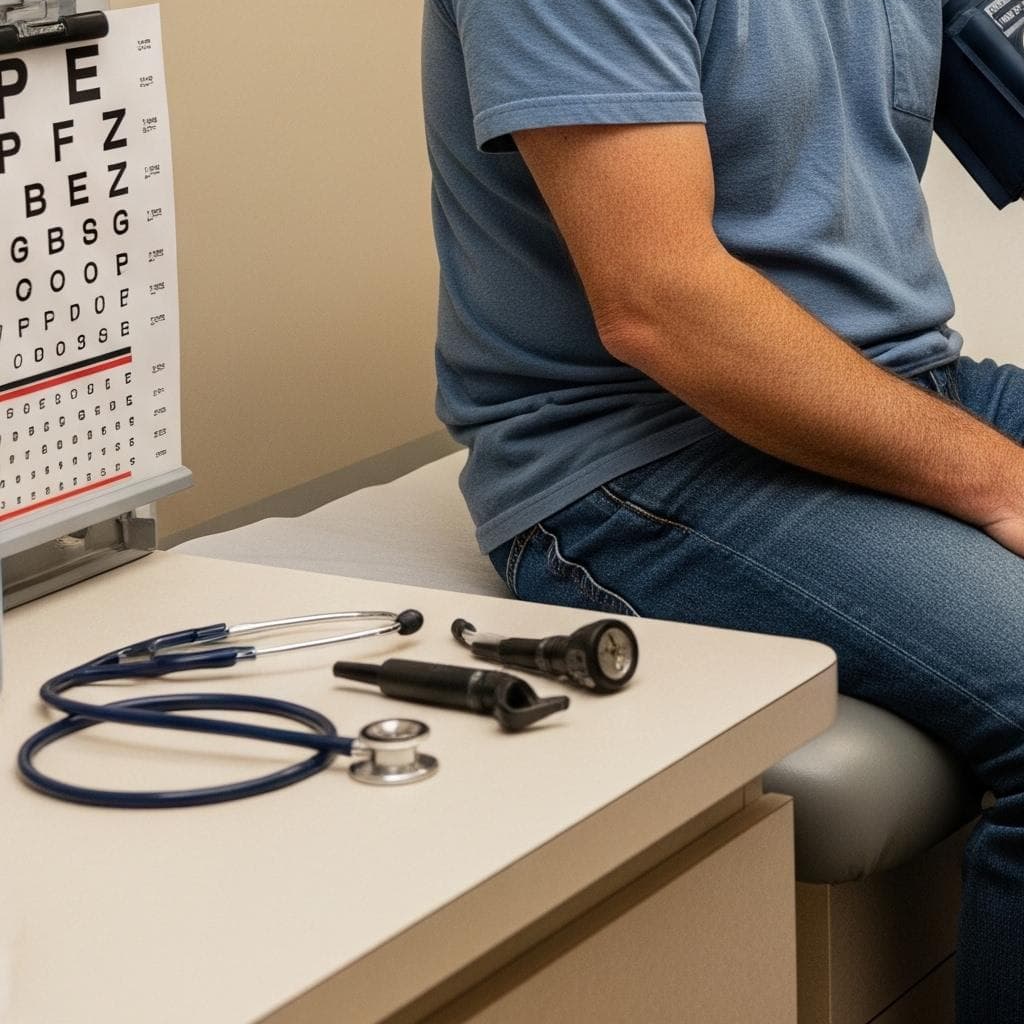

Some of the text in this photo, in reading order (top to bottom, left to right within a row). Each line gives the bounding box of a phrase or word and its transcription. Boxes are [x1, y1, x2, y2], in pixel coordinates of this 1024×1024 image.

[0, 43, 102, 120] P E
[0, 131, 22, 175] P
[52, 119, 75, 163] F
[102, 107, 128, 152] Z
[24, 182, 47, 219] B
[67, 170, 90, 208] E
[107, 160, 129, 199] Z
[10, 235, 29, 264] G
[47, 226, 66, 256] B
[82, 217, 99, 246] S
[112, 209, 130, 236] G
